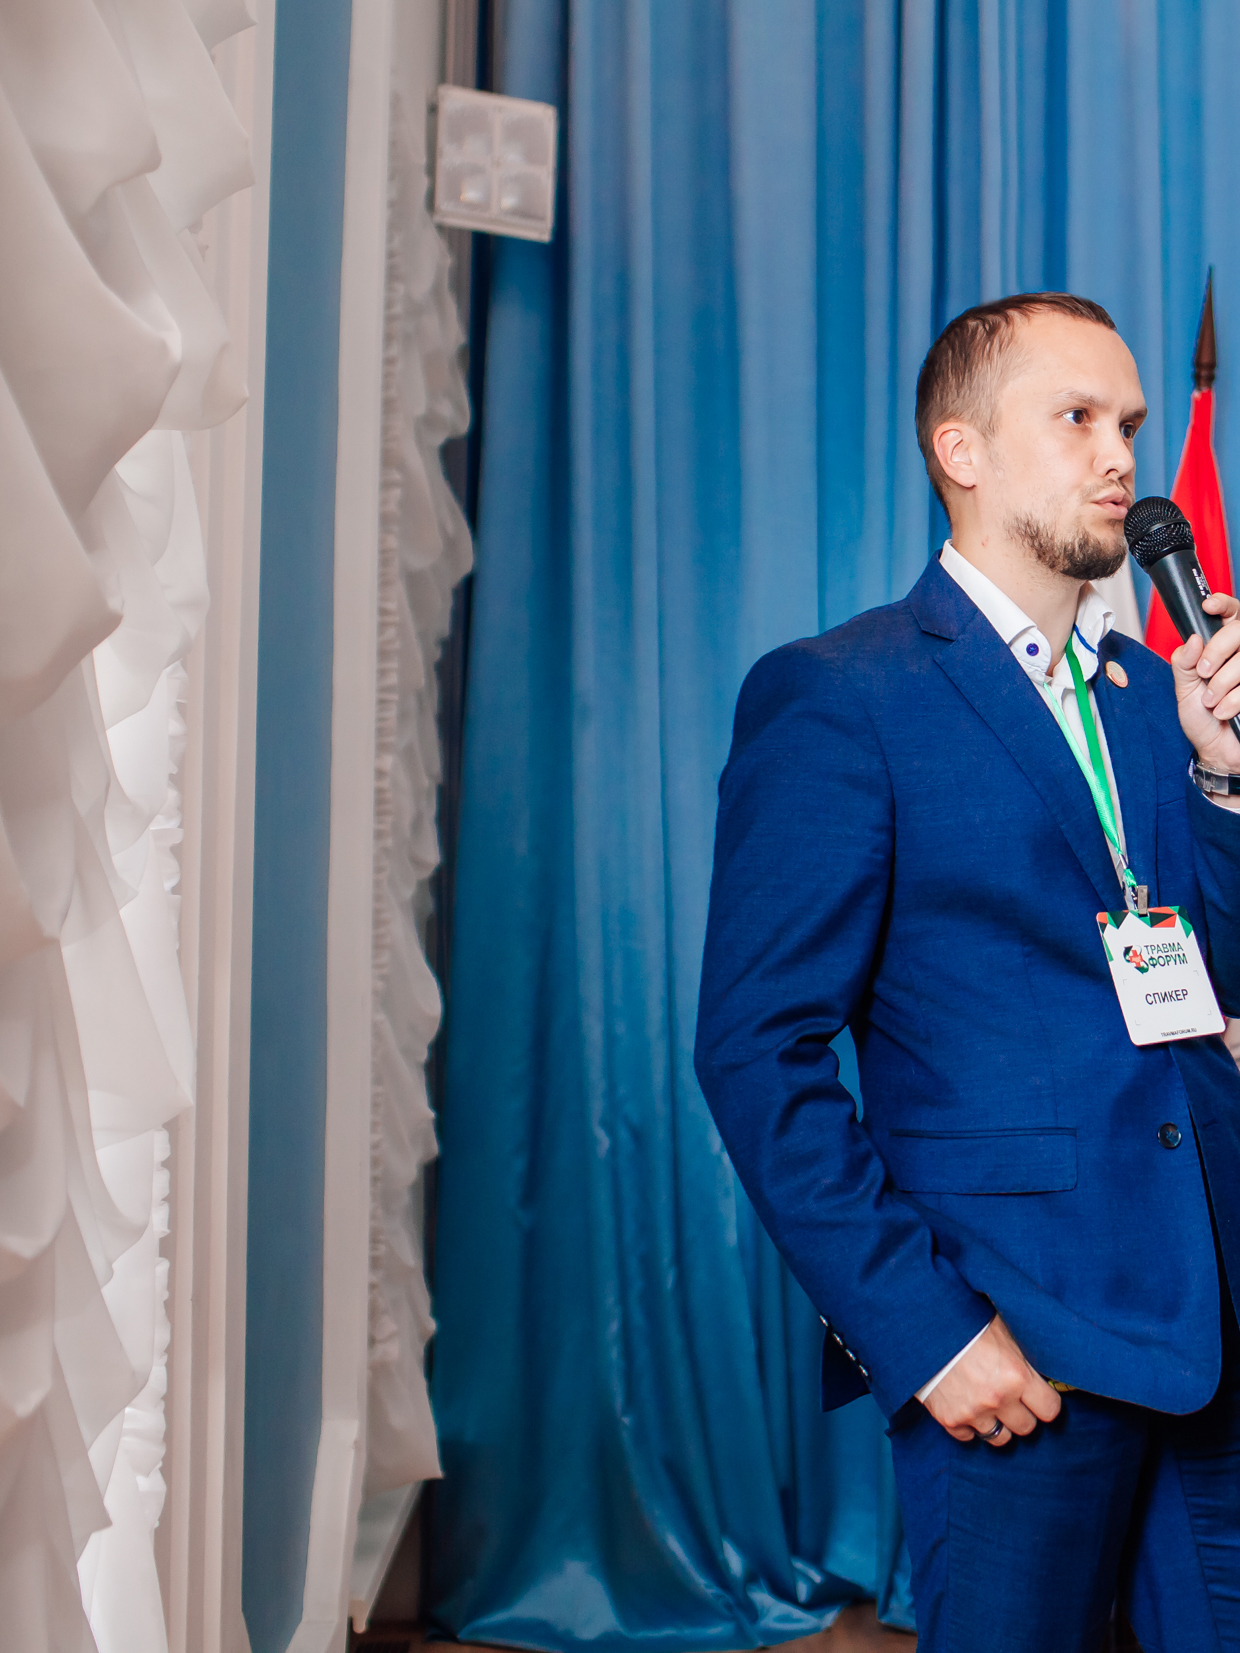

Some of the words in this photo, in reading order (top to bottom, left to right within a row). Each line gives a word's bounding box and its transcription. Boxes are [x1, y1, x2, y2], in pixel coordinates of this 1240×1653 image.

[1144, 942, 1183, 956] ТРАВМА
[1148, 953, 1187, 968] ФОРУМ
[1145, 988, 1188, 1005] СПИКЕР
